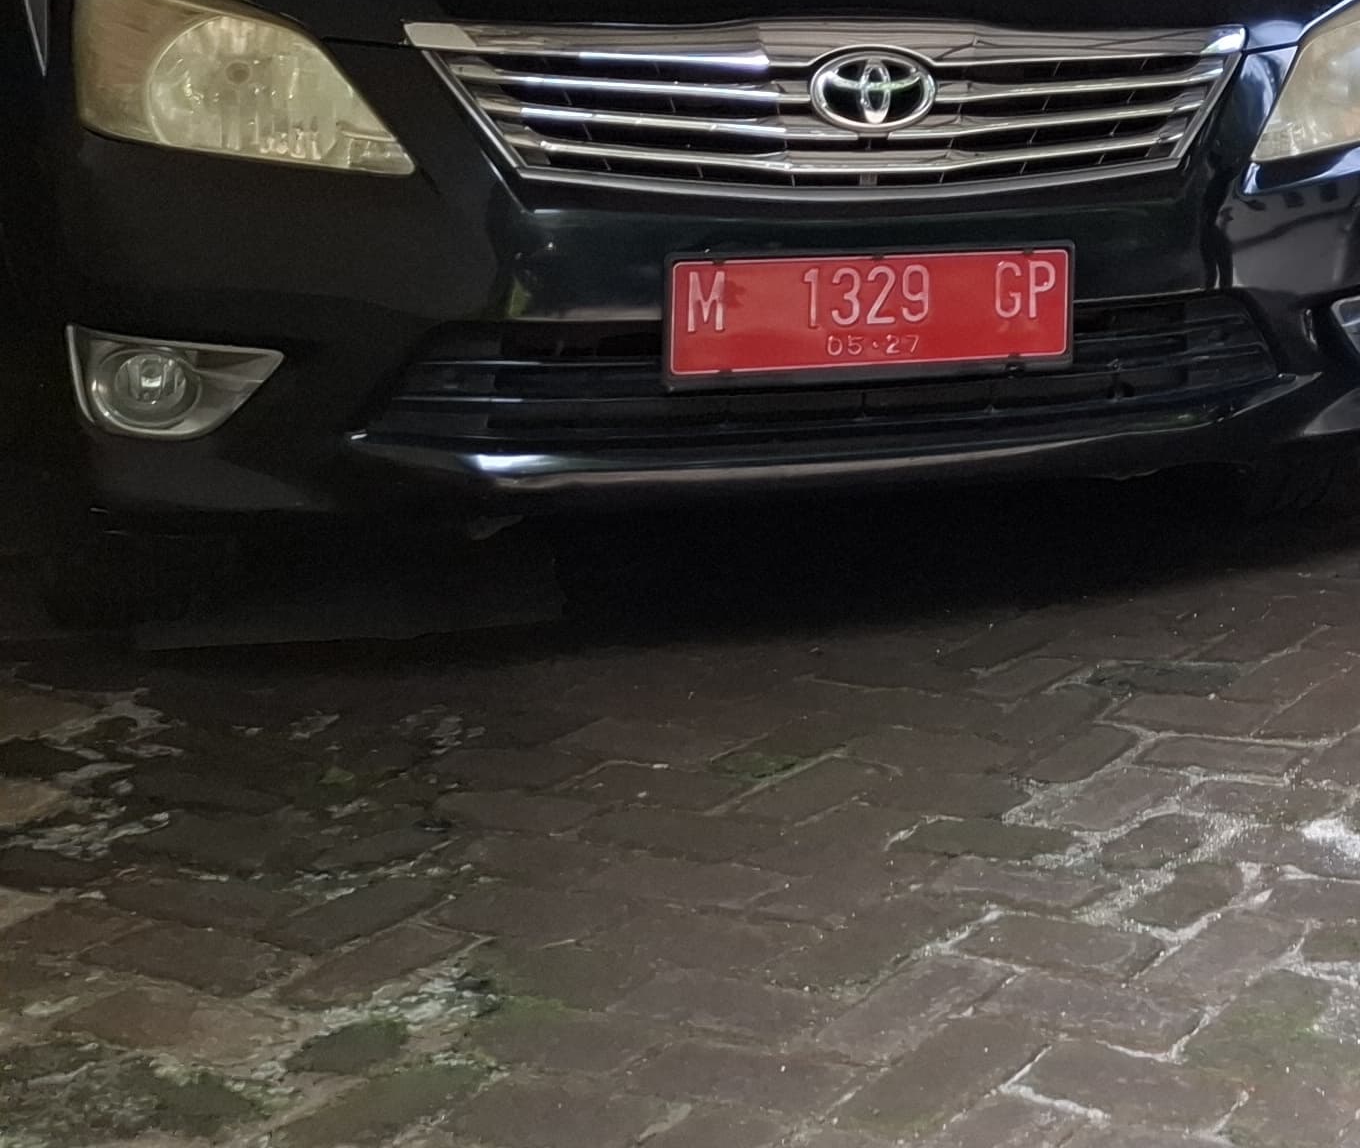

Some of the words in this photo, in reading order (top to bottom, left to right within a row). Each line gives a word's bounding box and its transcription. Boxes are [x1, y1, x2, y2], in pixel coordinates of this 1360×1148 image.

[687, 270, 726, 332] M
[802, 264, 930, 330] 1329
[994, 260, 1057, 319] GP
